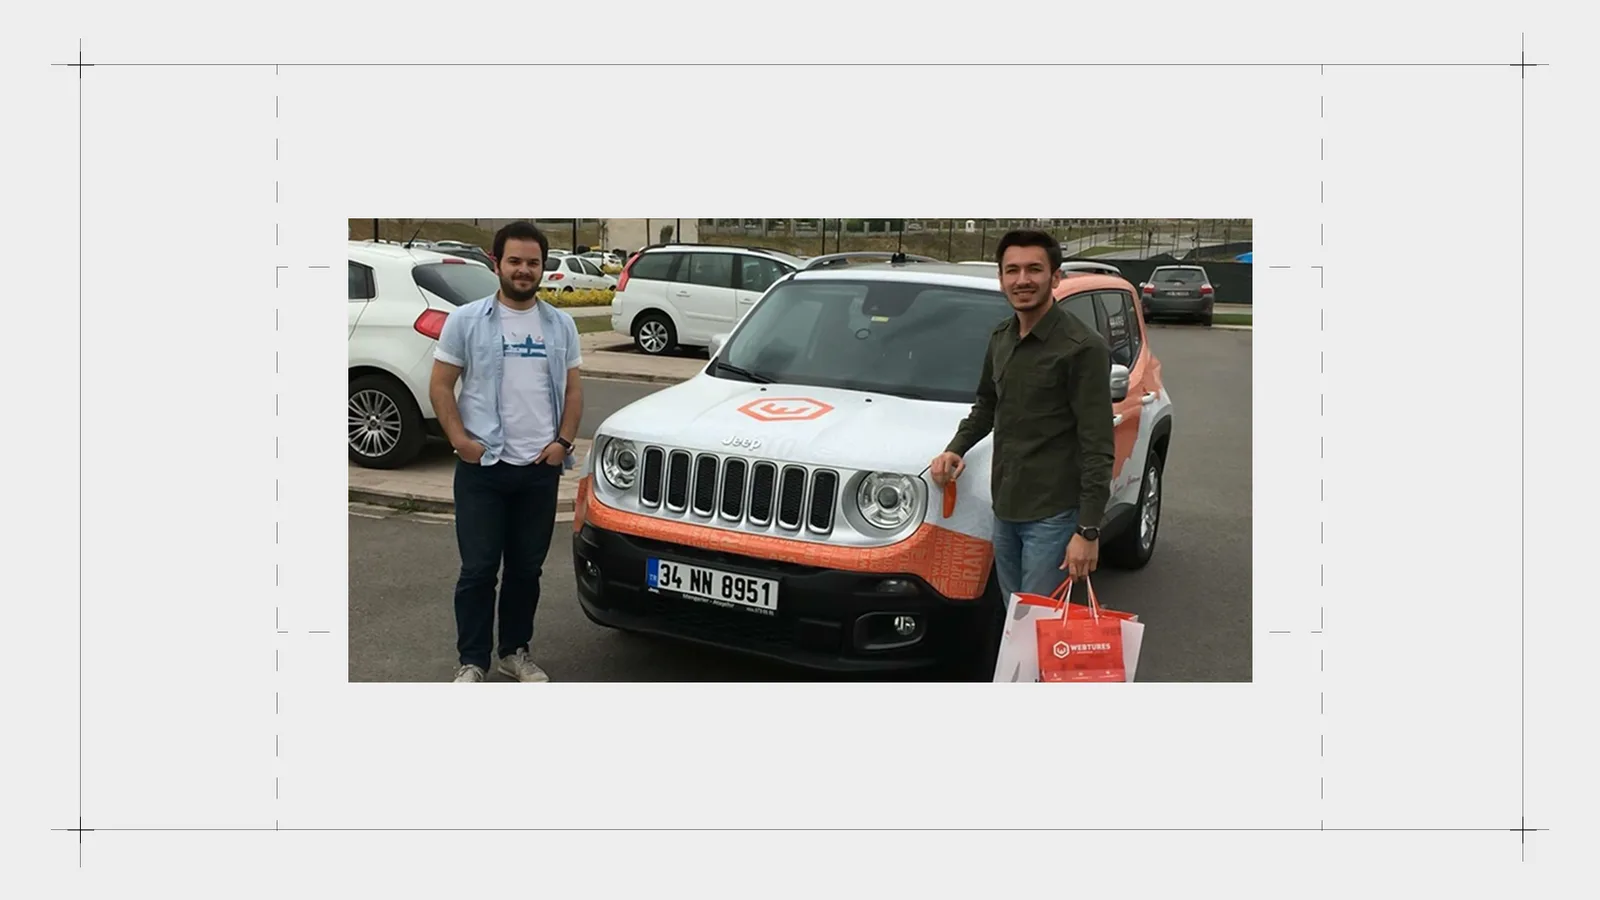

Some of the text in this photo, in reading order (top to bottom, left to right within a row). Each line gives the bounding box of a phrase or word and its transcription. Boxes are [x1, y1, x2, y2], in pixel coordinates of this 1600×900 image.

[722, 435, 762, 451] Jeep
[660, 564, 770, 606] 34 NN 8951
[1070, 642, 1110, 651] WEBTURES
